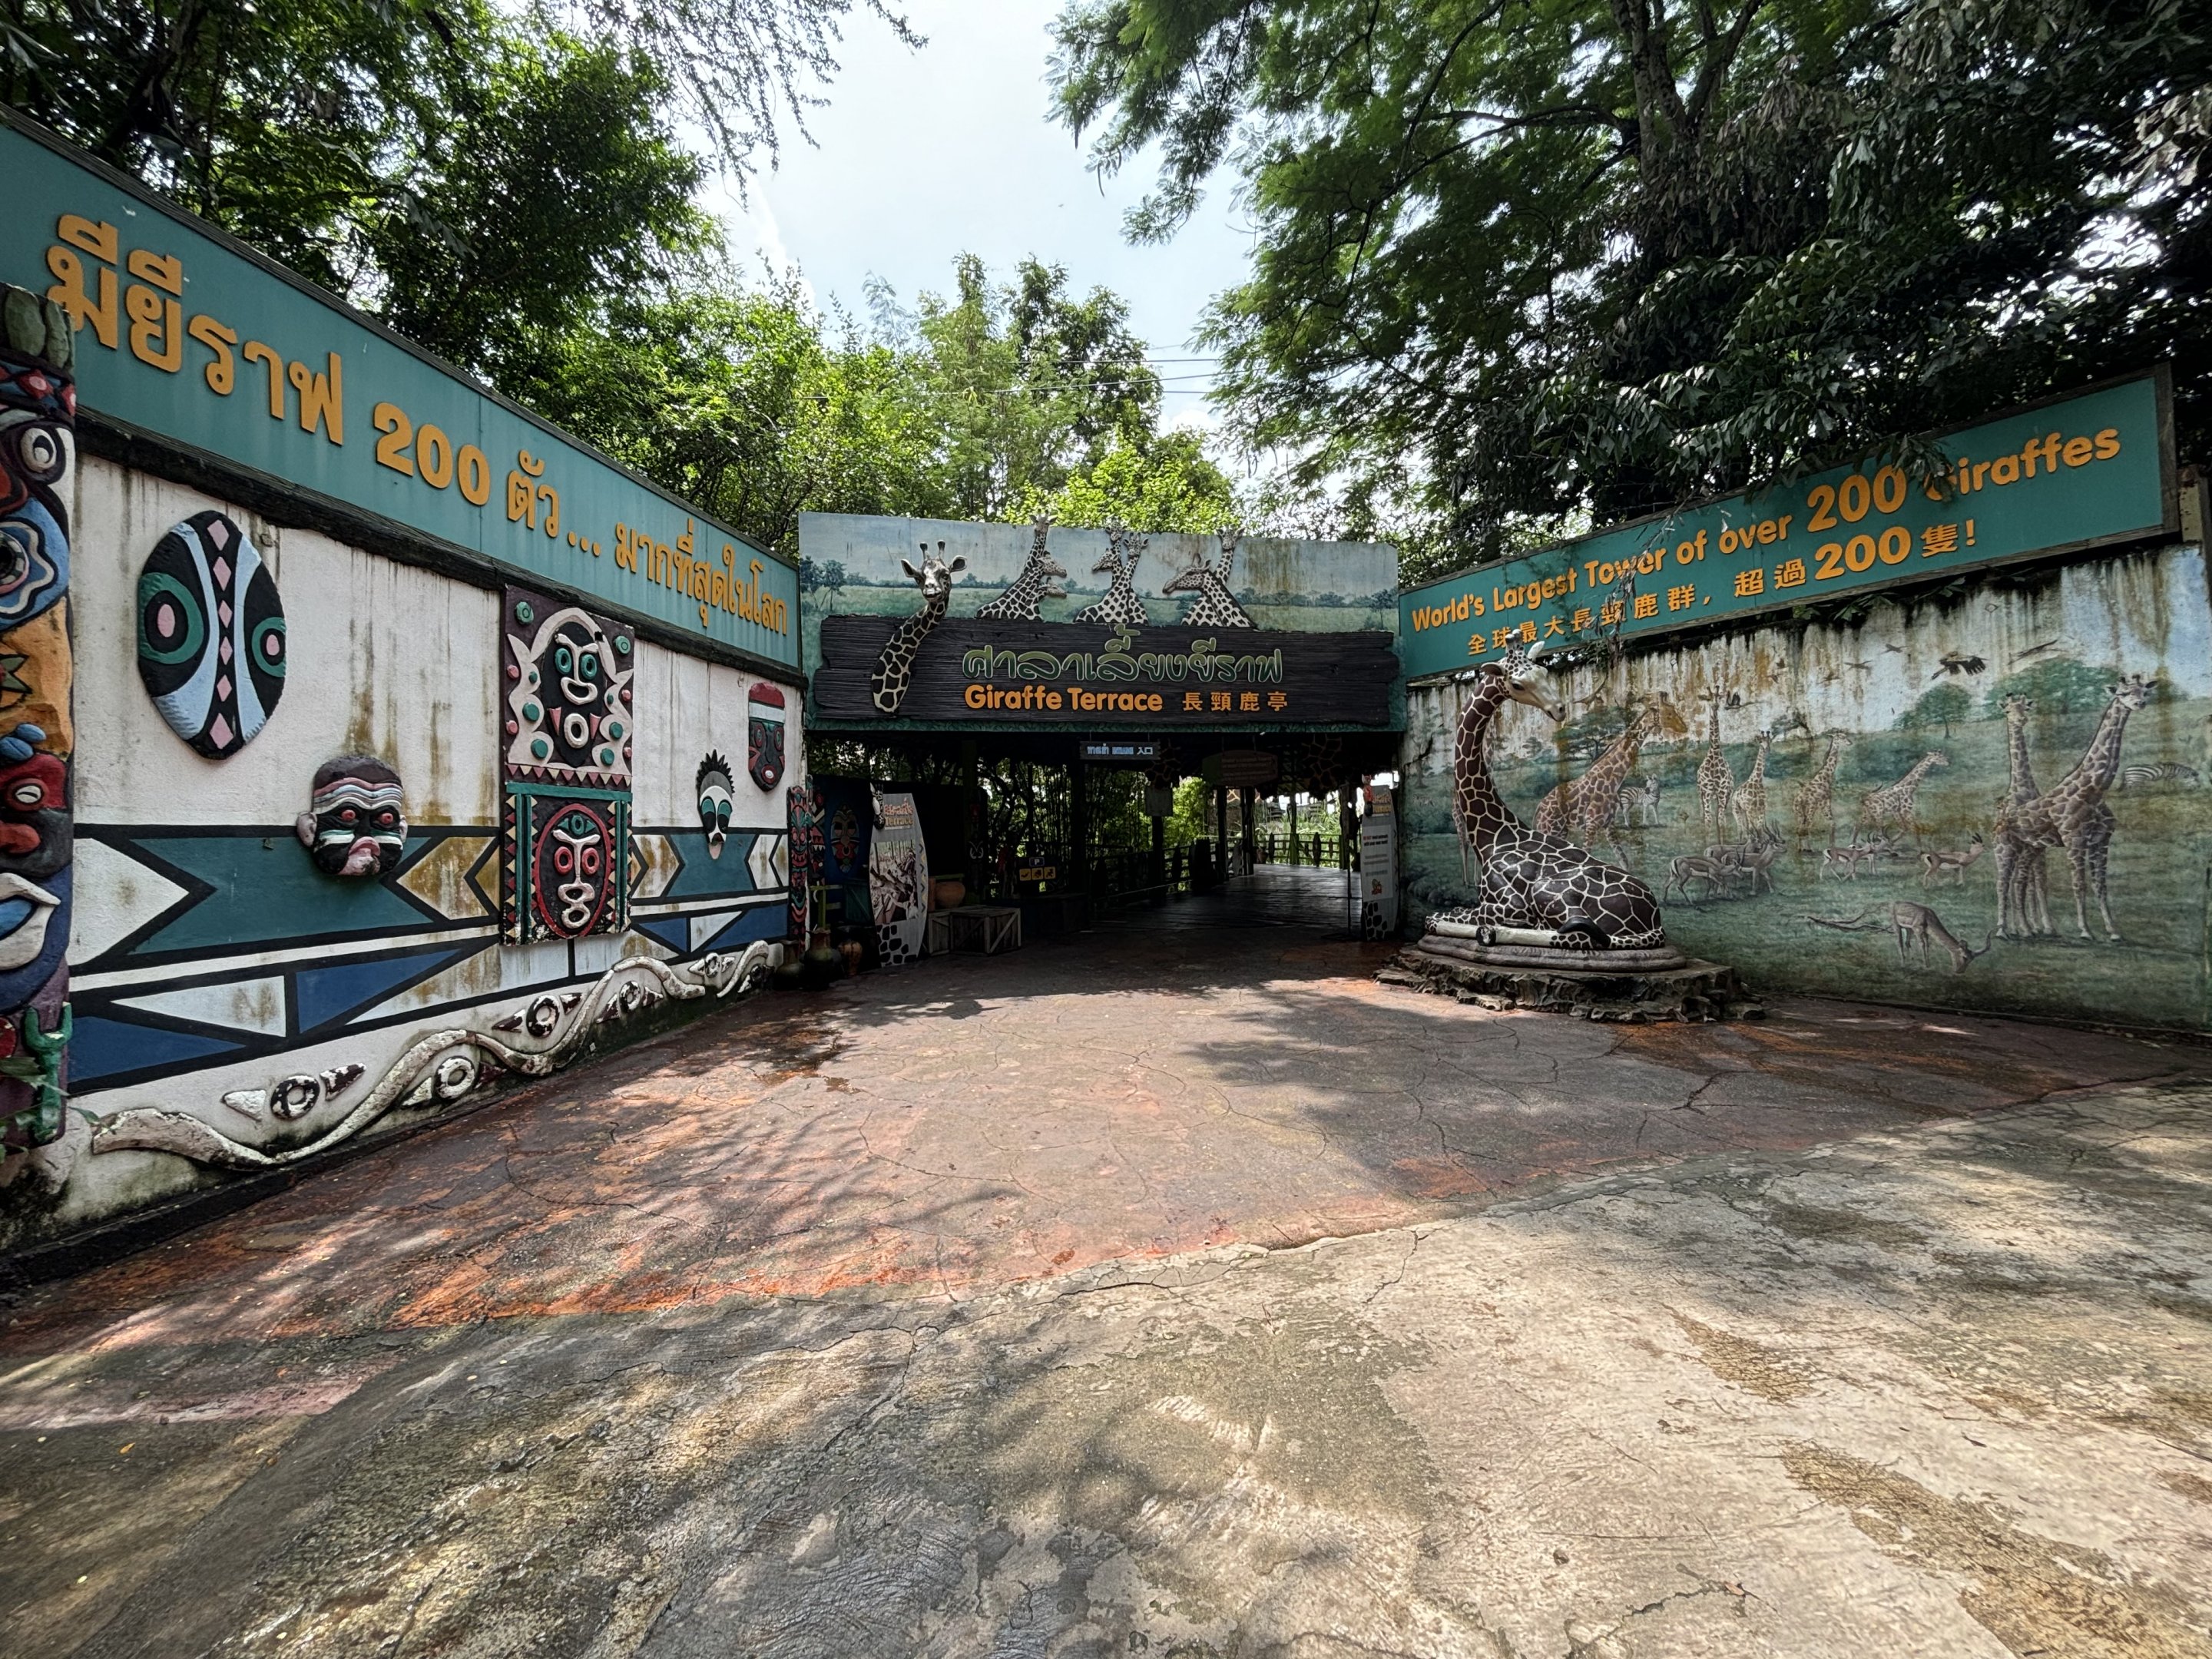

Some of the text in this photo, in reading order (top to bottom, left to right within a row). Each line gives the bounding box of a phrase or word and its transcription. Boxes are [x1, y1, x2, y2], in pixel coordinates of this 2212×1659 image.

[46, 214, 344, 445] มียีราฟ
[374, 402, 491, 506] 200
[615, 518, 788, 635] มากที่สุดในโลก
[1412, 594, 1485, 632] World's
[1493, 568, 1578, 612] Largest
[1584, 547, 1667, 588] Tower
[1676, 528, 1708, 565] of
[1718, 515, 1793, 555] over
[1806, 464, 1908, 533] 200
[962, 623, 1283, 683] ศาลาเลี้ยงยีราฟ
[965, 684, 1164, 712] Giraffe Terrace
[1181, 691, 1288, 712] 長頸鹿亭
[1137, 747, 1154, 755] 入口
